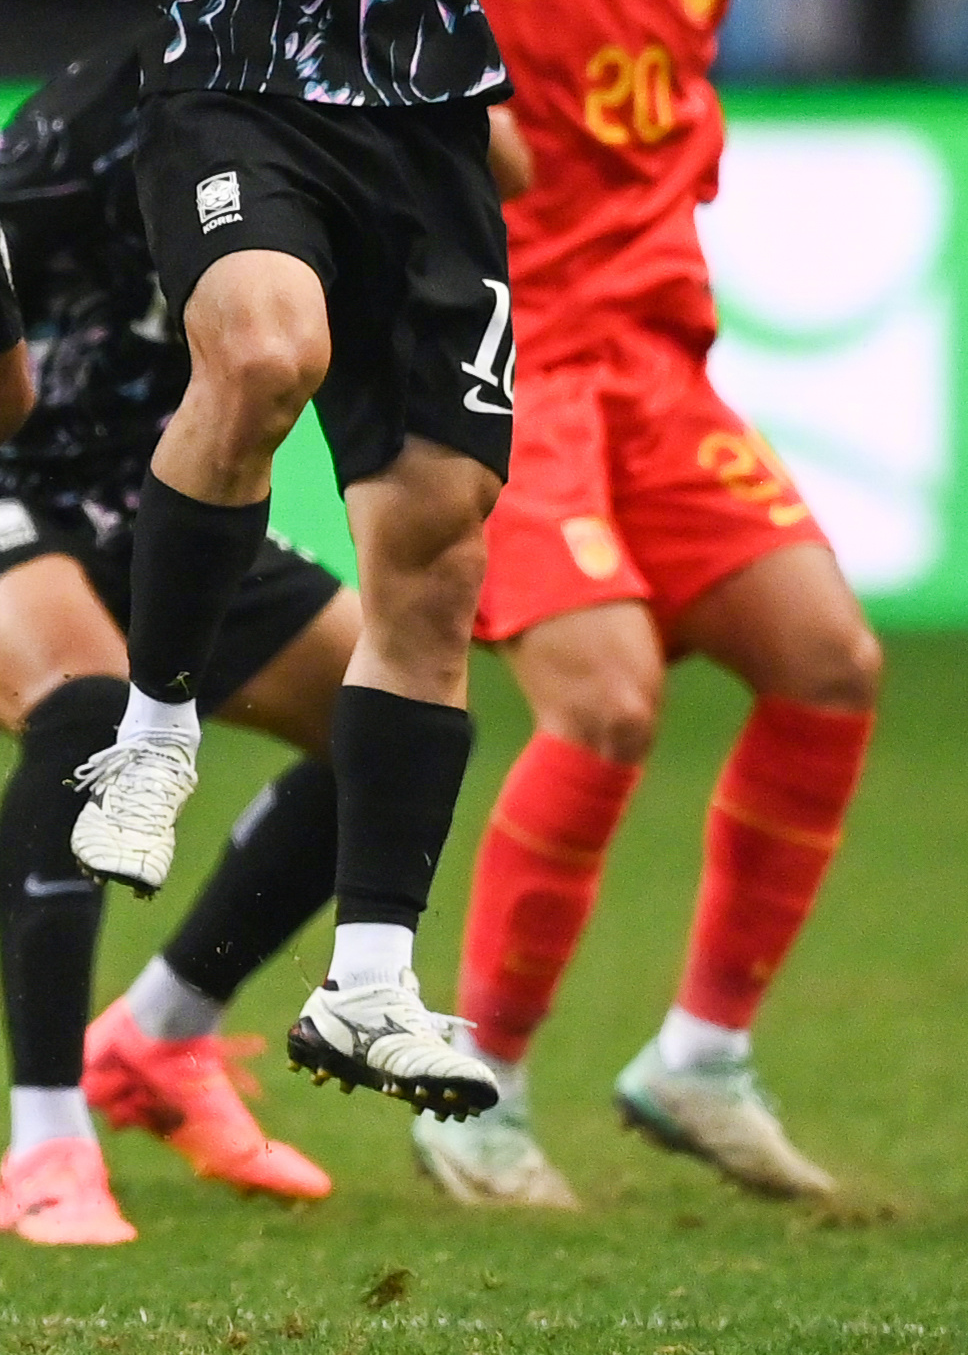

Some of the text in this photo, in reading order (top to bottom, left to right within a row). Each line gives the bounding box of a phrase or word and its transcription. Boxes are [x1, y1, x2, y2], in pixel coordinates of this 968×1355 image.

[585, 44, 675, 146] 20
[202, 212, 244, 235] KOREA
[460, 278, 516, 404] 1
